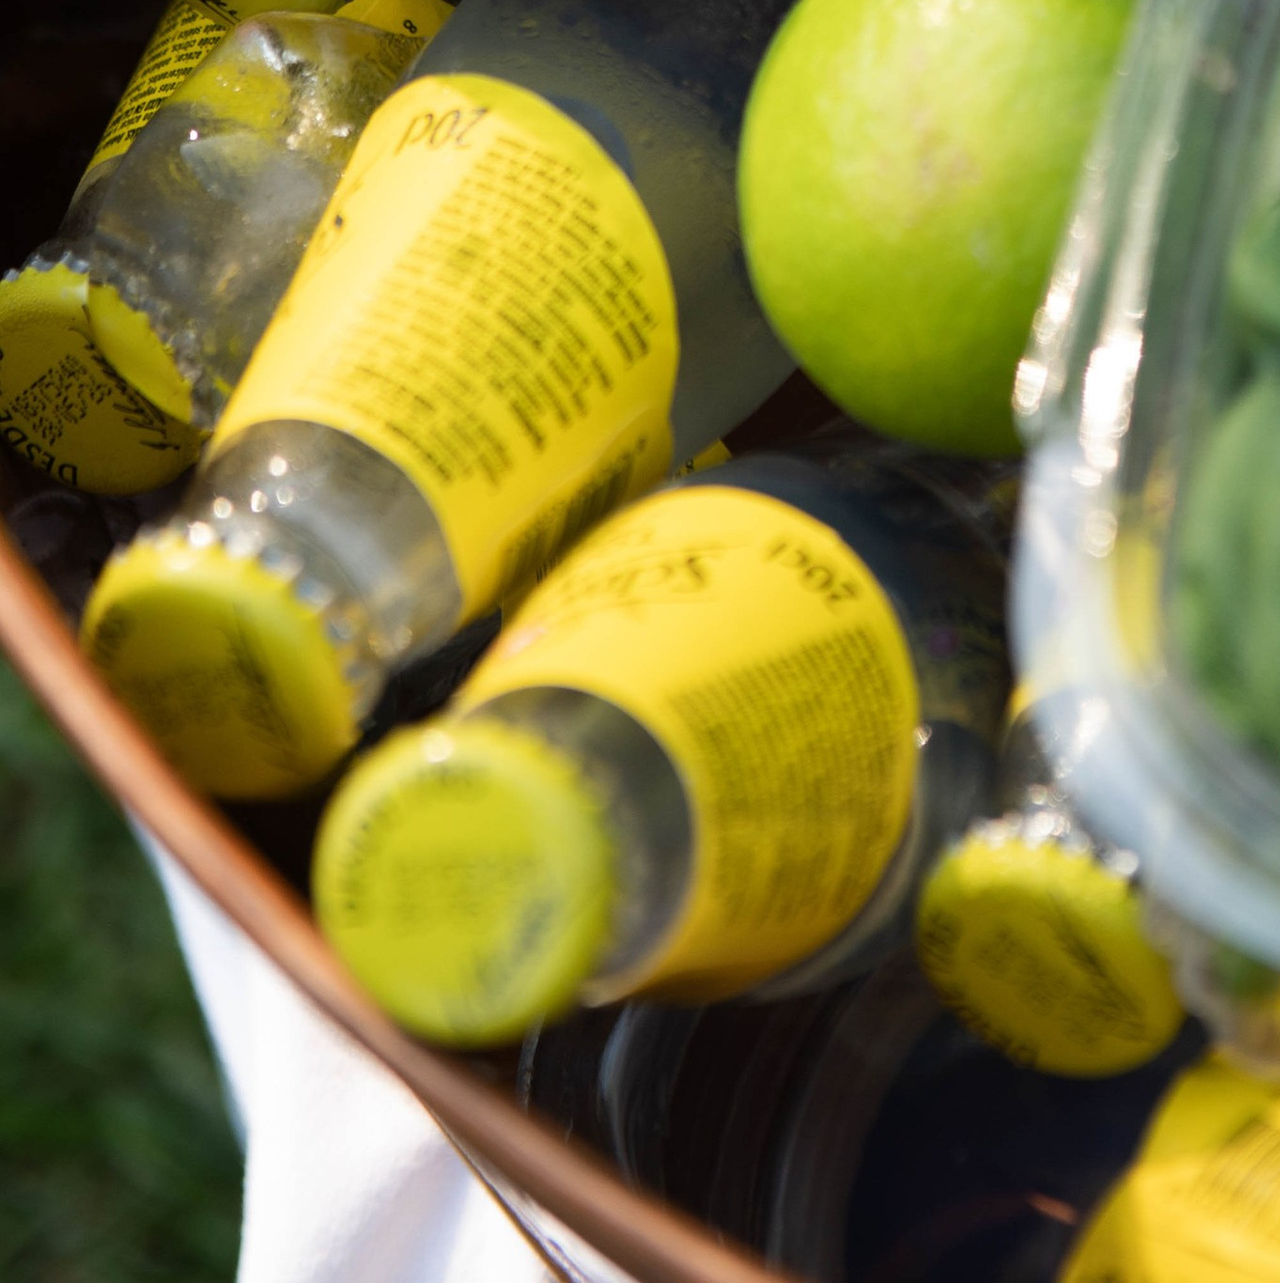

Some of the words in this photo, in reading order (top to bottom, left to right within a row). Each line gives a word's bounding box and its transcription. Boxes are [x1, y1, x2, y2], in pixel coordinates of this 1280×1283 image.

[403, 20, 417, 34] 8
[395, 104, 490, 153] 20cl
[0, 409, 78, 485] DESD
